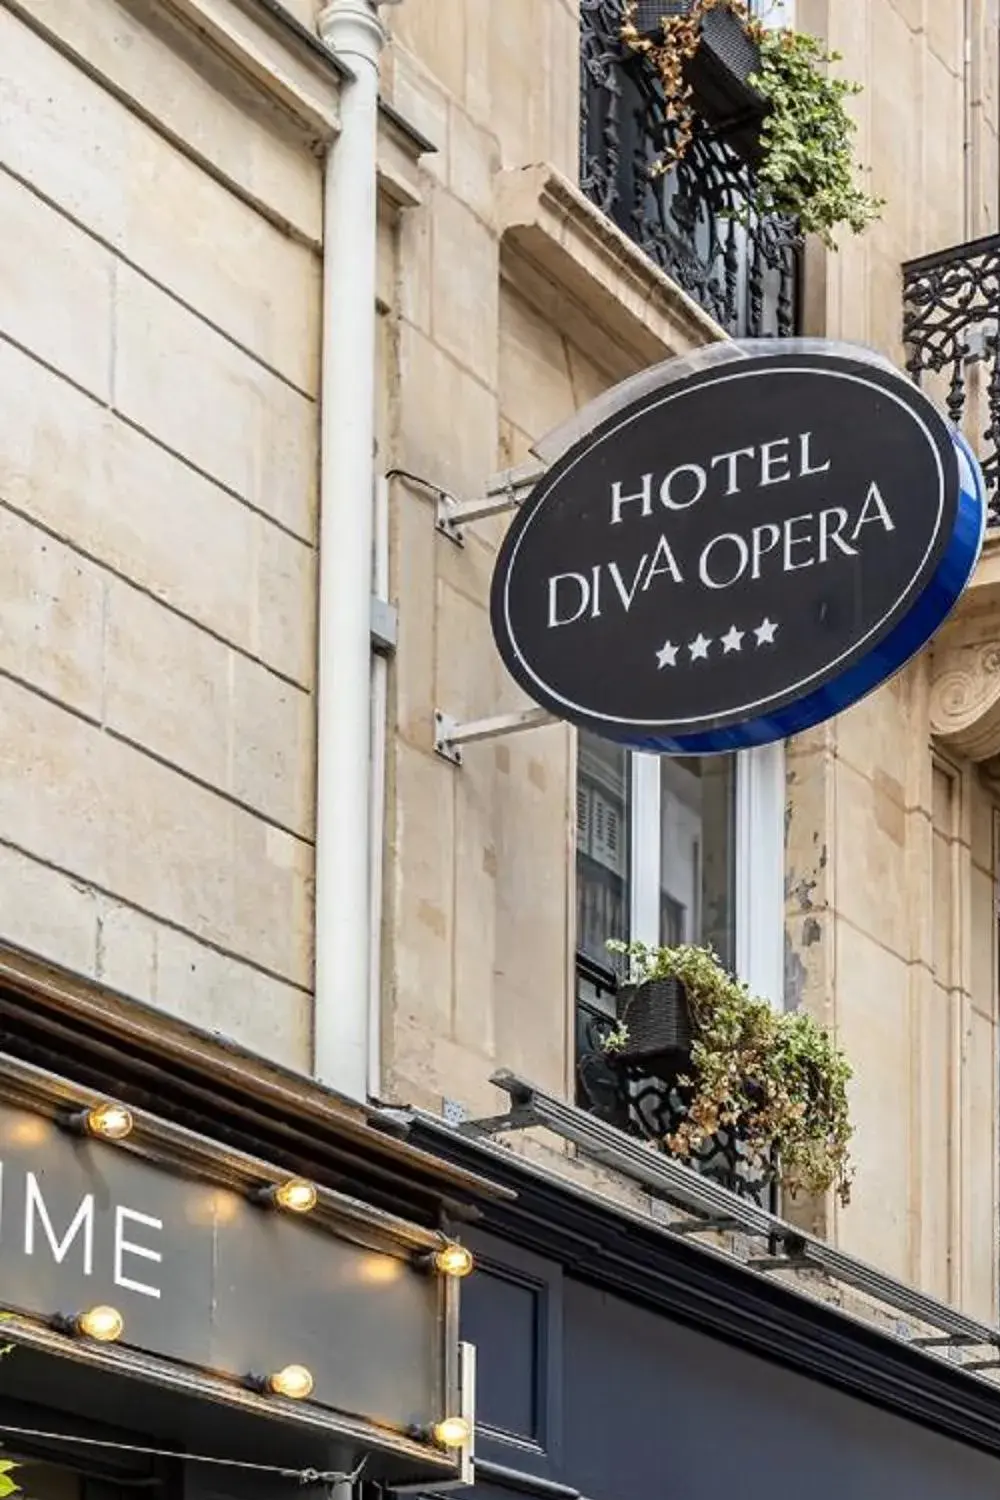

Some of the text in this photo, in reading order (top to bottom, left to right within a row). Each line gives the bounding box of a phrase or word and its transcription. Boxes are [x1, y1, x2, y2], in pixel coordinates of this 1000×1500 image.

[609, 431, 830, 524] HOTEL
[547, 480, 896, 628] DIVA OPERA
